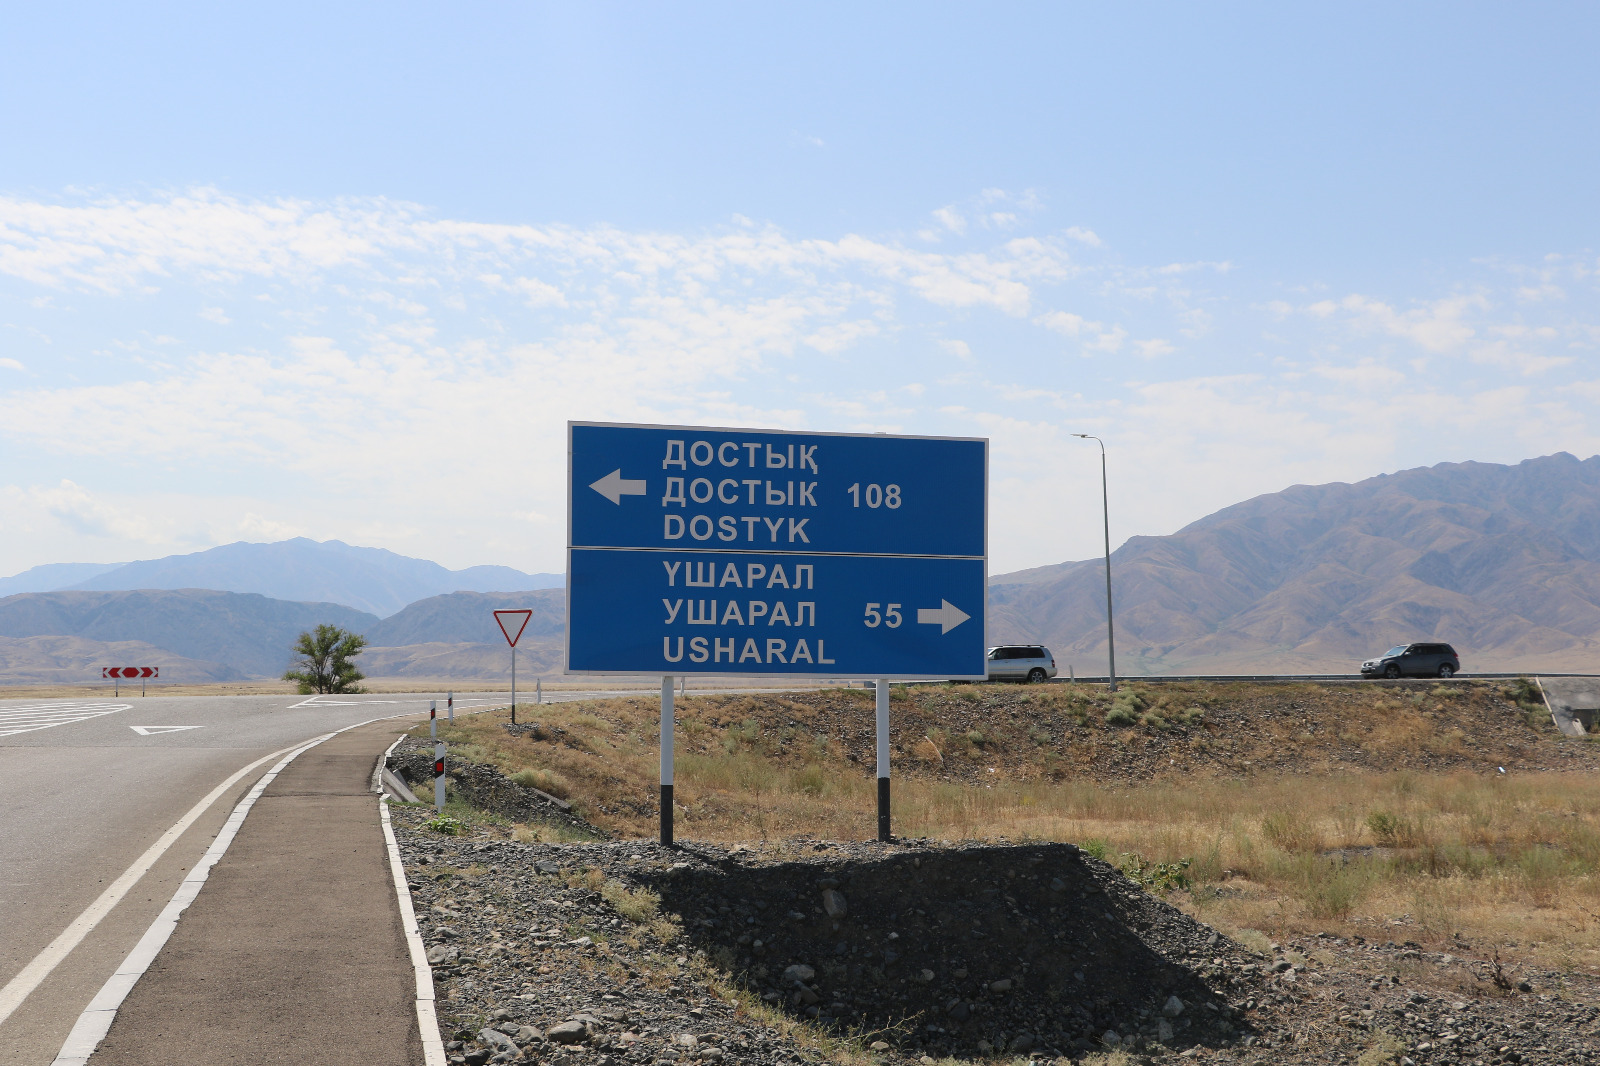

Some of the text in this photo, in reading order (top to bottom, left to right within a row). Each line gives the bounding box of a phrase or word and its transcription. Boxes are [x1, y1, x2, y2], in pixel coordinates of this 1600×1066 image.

[662, 439, 818, 475] ДОСТЫҚ
[661, 477, 902, 509] ДОСТЫК 108
[664, 515, 810, 543] DOSTYK
[662, 599, 903, 628] УШАРАЛ 55
[663, 637, 836, 665] USHARAL
